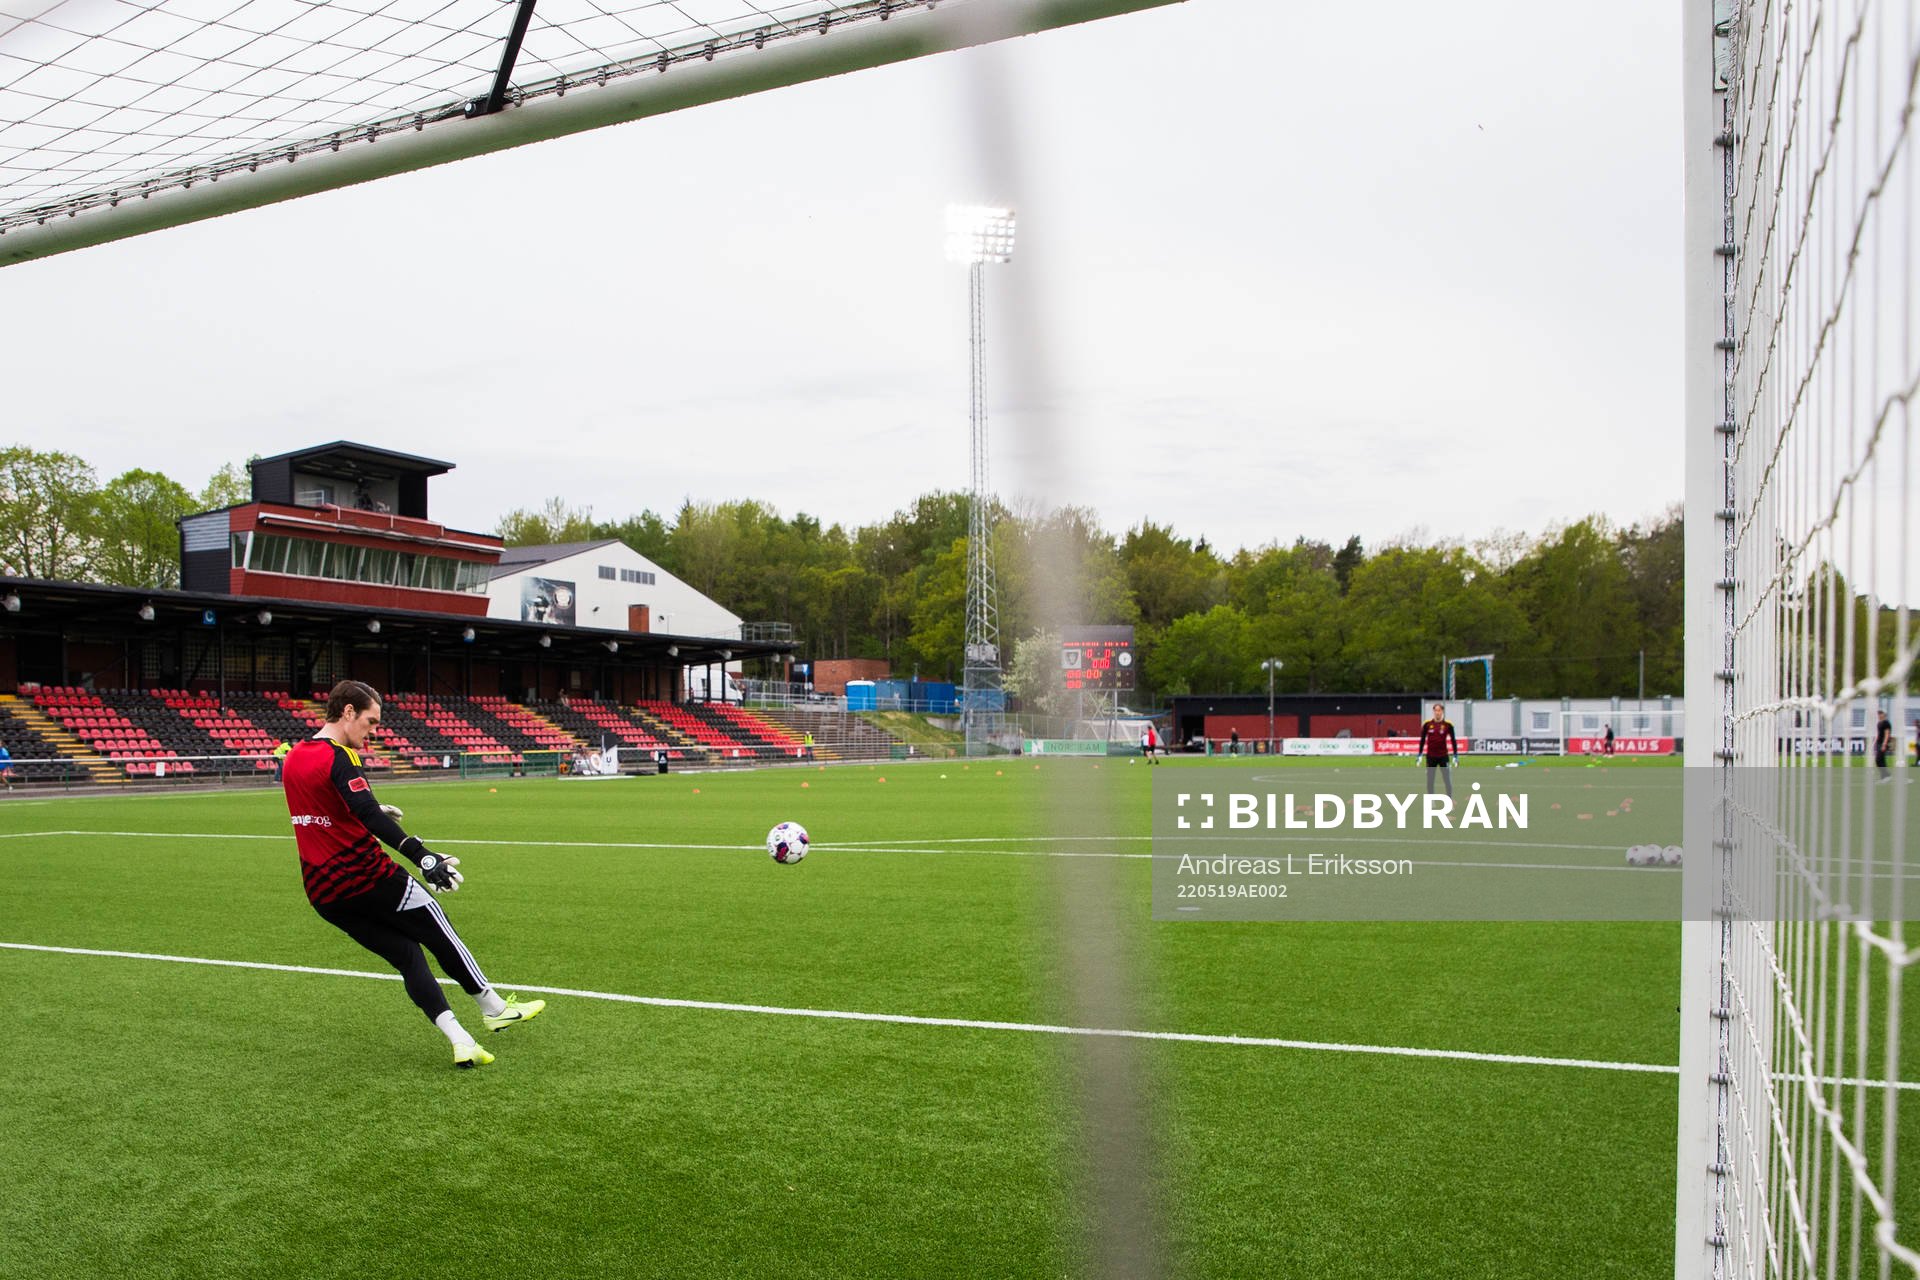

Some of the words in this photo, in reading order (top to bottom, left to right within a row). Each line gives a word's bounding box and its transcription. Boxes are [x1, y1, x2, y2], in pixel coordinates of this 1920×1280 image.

[205, 610, 214, 622] C
[1487, 740, 1517, 751] Heba
[1581, 740, 1660, 751] BAHAUS
